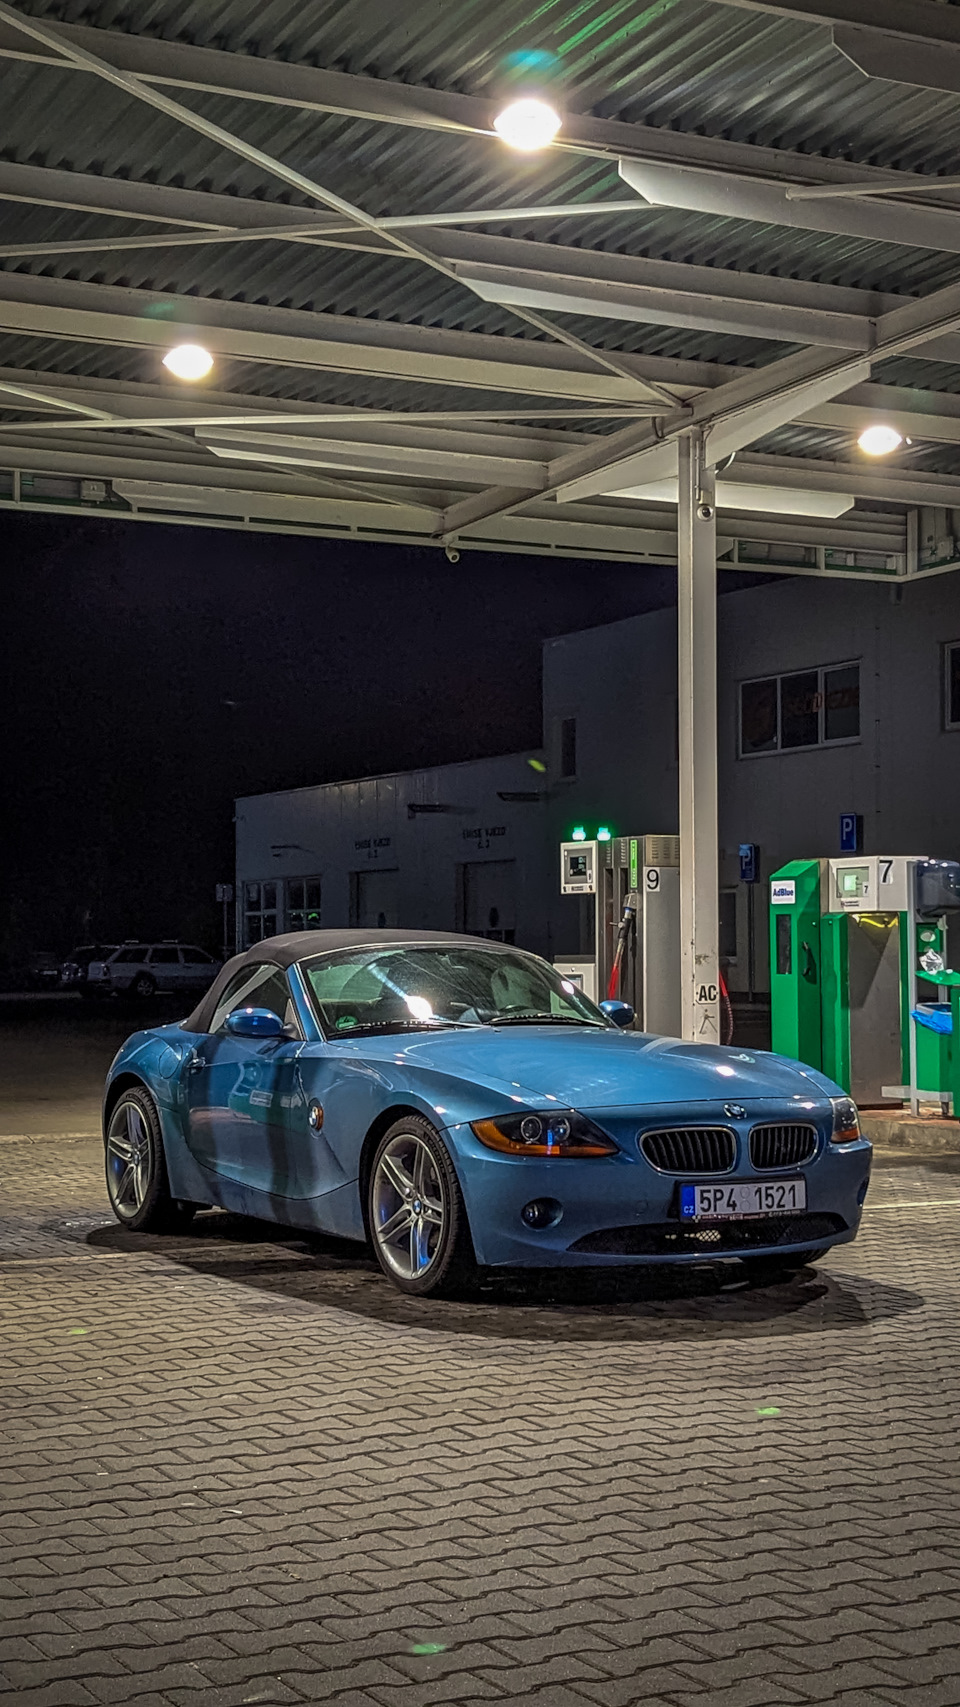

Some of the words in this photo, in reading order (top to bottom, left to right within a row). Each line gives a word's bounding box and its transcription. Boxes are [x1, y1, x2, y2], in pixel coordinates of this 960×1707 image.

[843, 818, 853, 840] P
[647, 869, 659, 889] 9
[879, 860, 893, 883] 7
[773, 888, 793, 897] AdBlue
[864, 885, 868, 893] 7
[698, 985, 717, 1001] AC
[700, 1188, 737, 1212] 5P4
[754, 1184, 796, 1210] 1521
[683, 1205, 694, 1213] CZ
